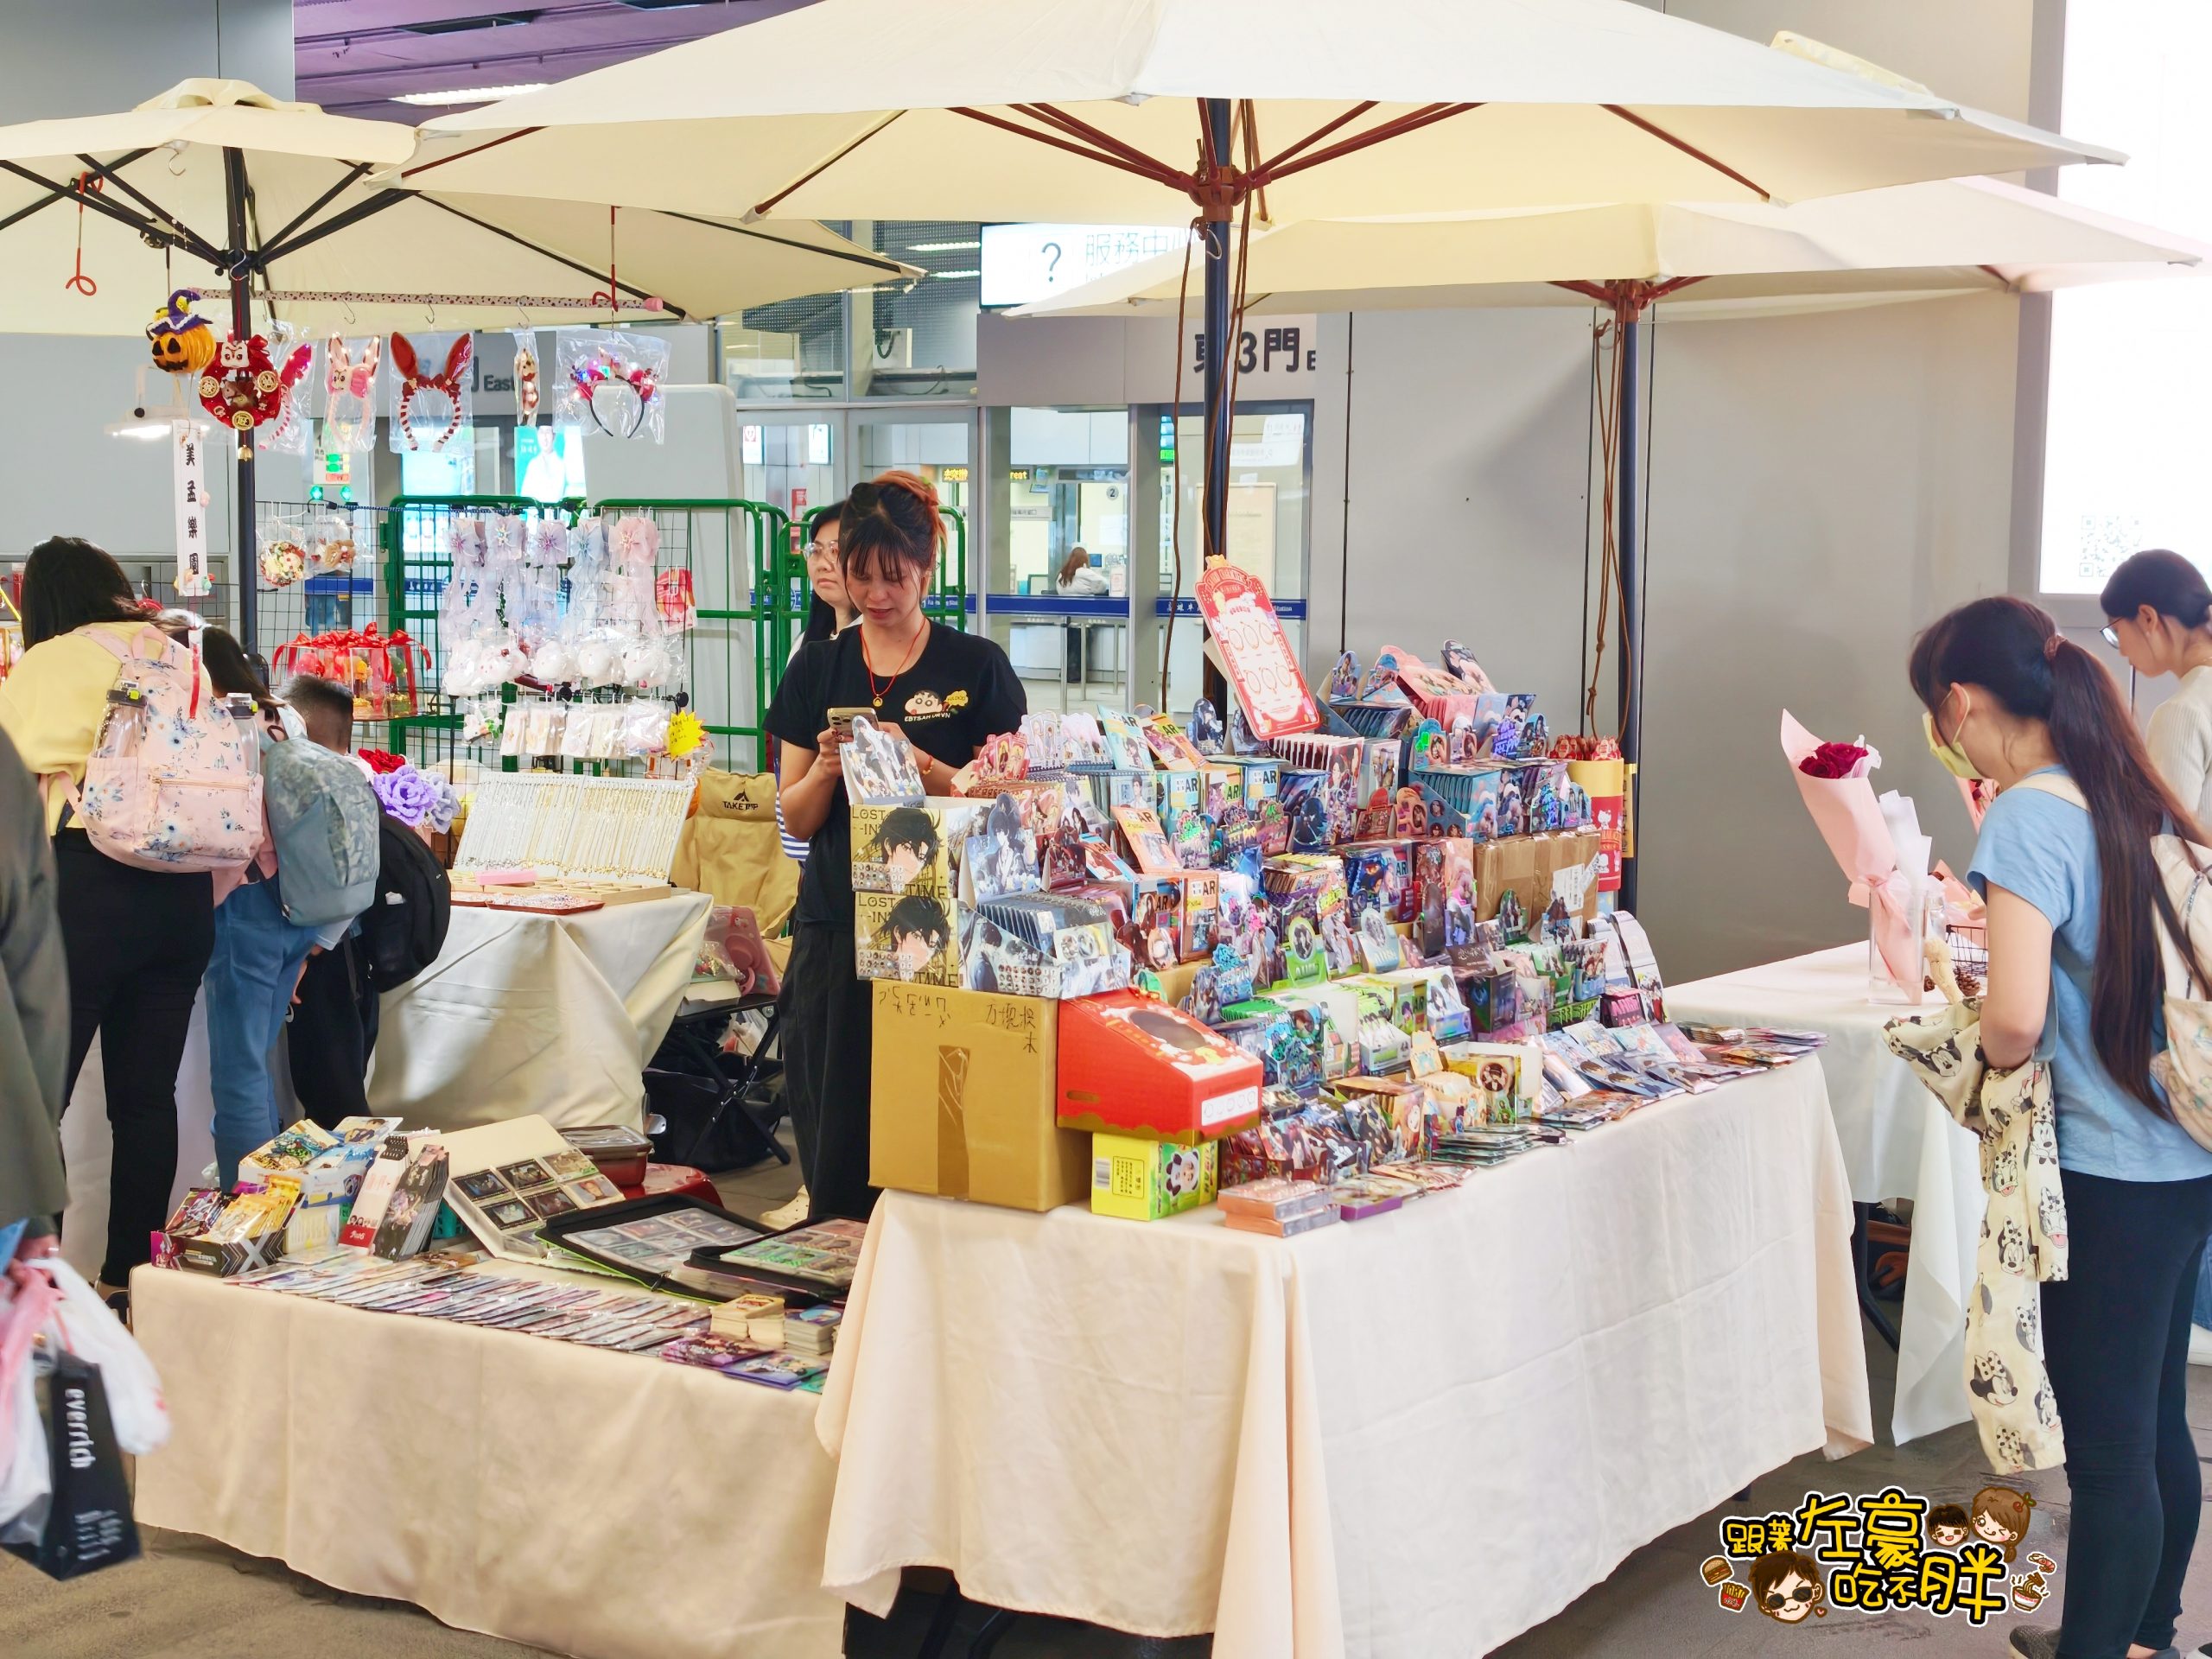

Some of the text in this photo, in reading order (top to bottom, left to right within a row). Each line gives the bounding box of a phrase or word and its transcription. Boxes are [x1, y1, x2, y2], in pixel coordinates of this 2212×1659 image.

[186, 442, 200, 575] 美孟樂園
[1162, 724, 1179, 736] AR
[1185, 778, 1198, 792] AR
[1263, 770, 1277, 785] AR
[852, 804, 886, 820] LOST
[1139, 811, 1155, 823] AR
[1396, 861, 1408, 876] AR
[906, 883, 948, 899] TIME
[1202, 880, 1217, 895] AR
[858, 893, 895, 907] LOST
[1155, 895, 1168, 912] AR
